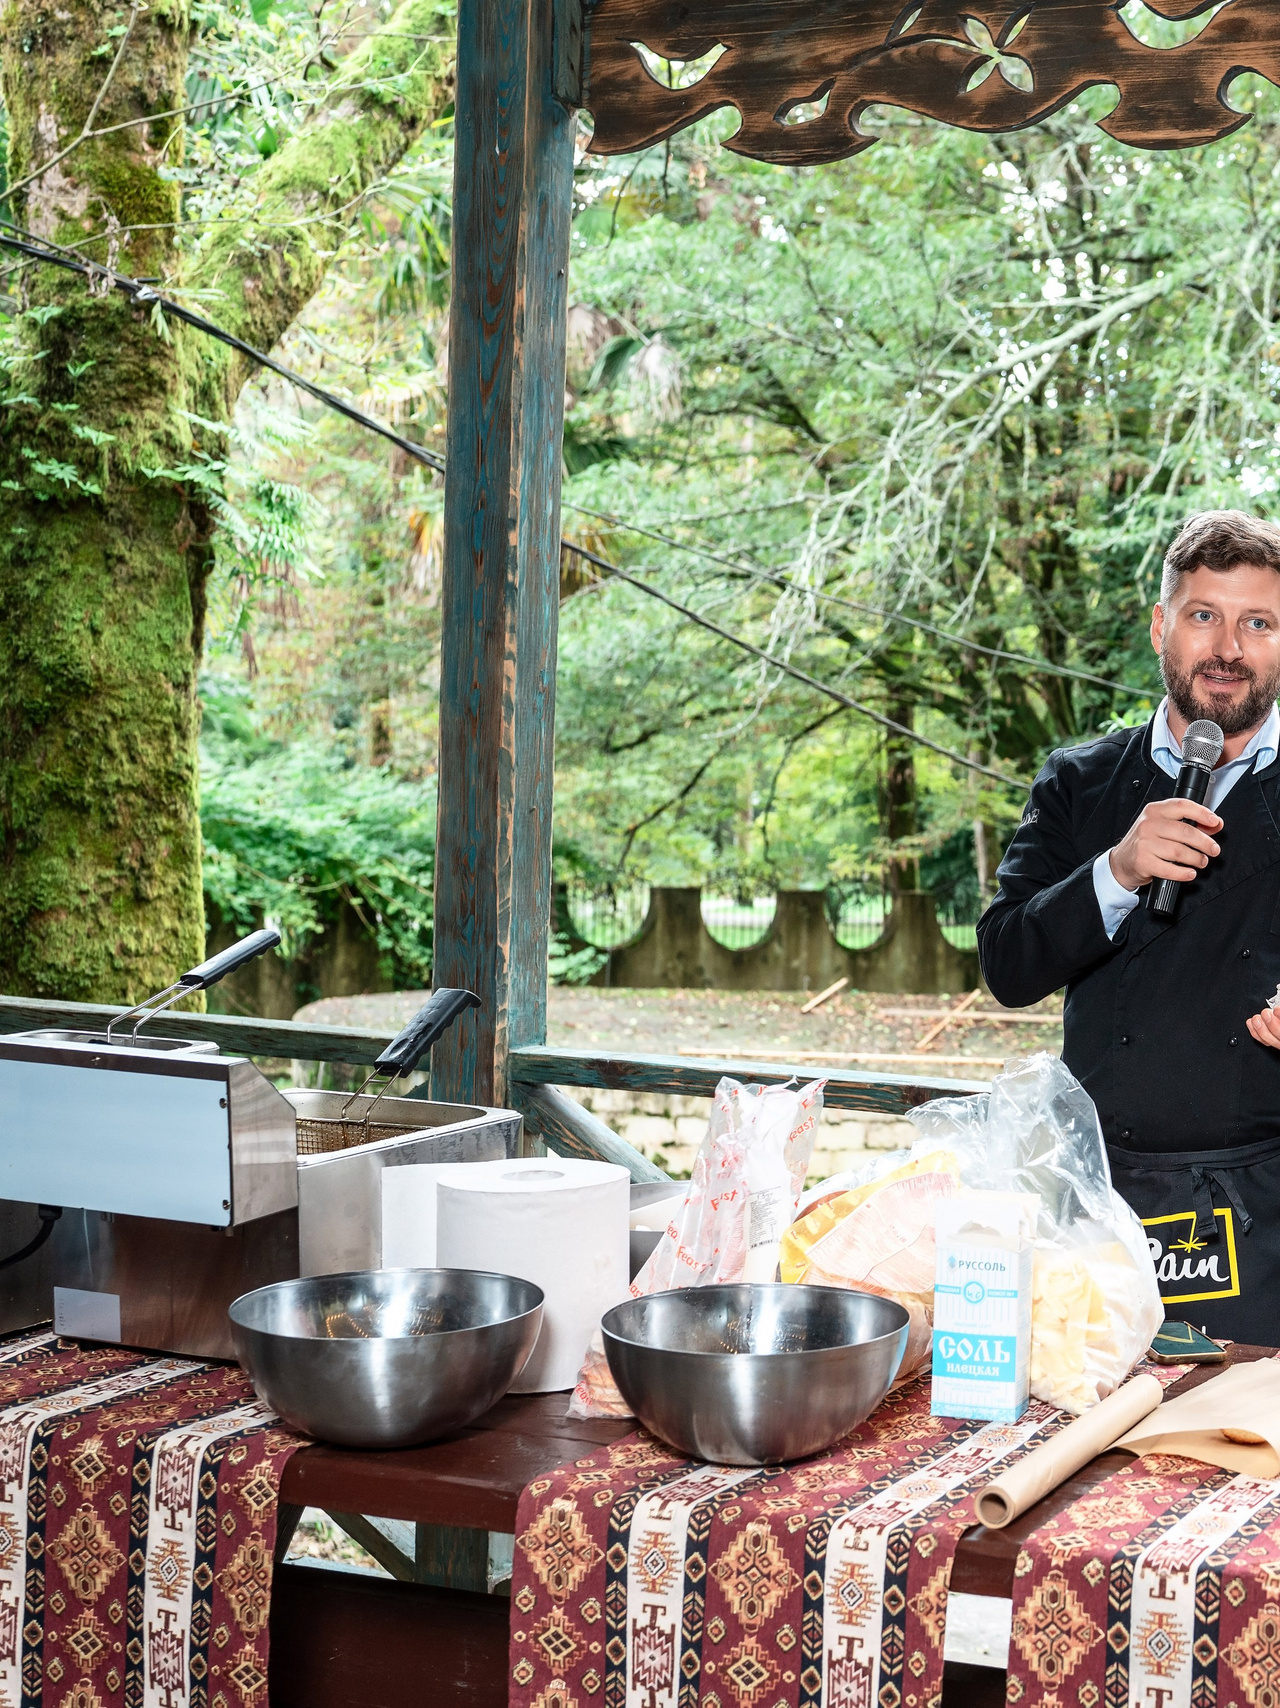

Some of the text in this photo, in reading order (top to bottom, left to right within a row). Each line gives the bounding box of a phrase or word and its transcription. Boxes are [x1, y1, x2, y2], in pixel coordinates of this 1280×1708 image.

[711, 1190, 738, 1211] Fst
[958, 1260, 1006, 1272] РУССОЛЬ
[938, 1335, 1011, 1364] СОЛЬ
[946, 1362, 1000, 1377] ИЛЕЦКАЯ
